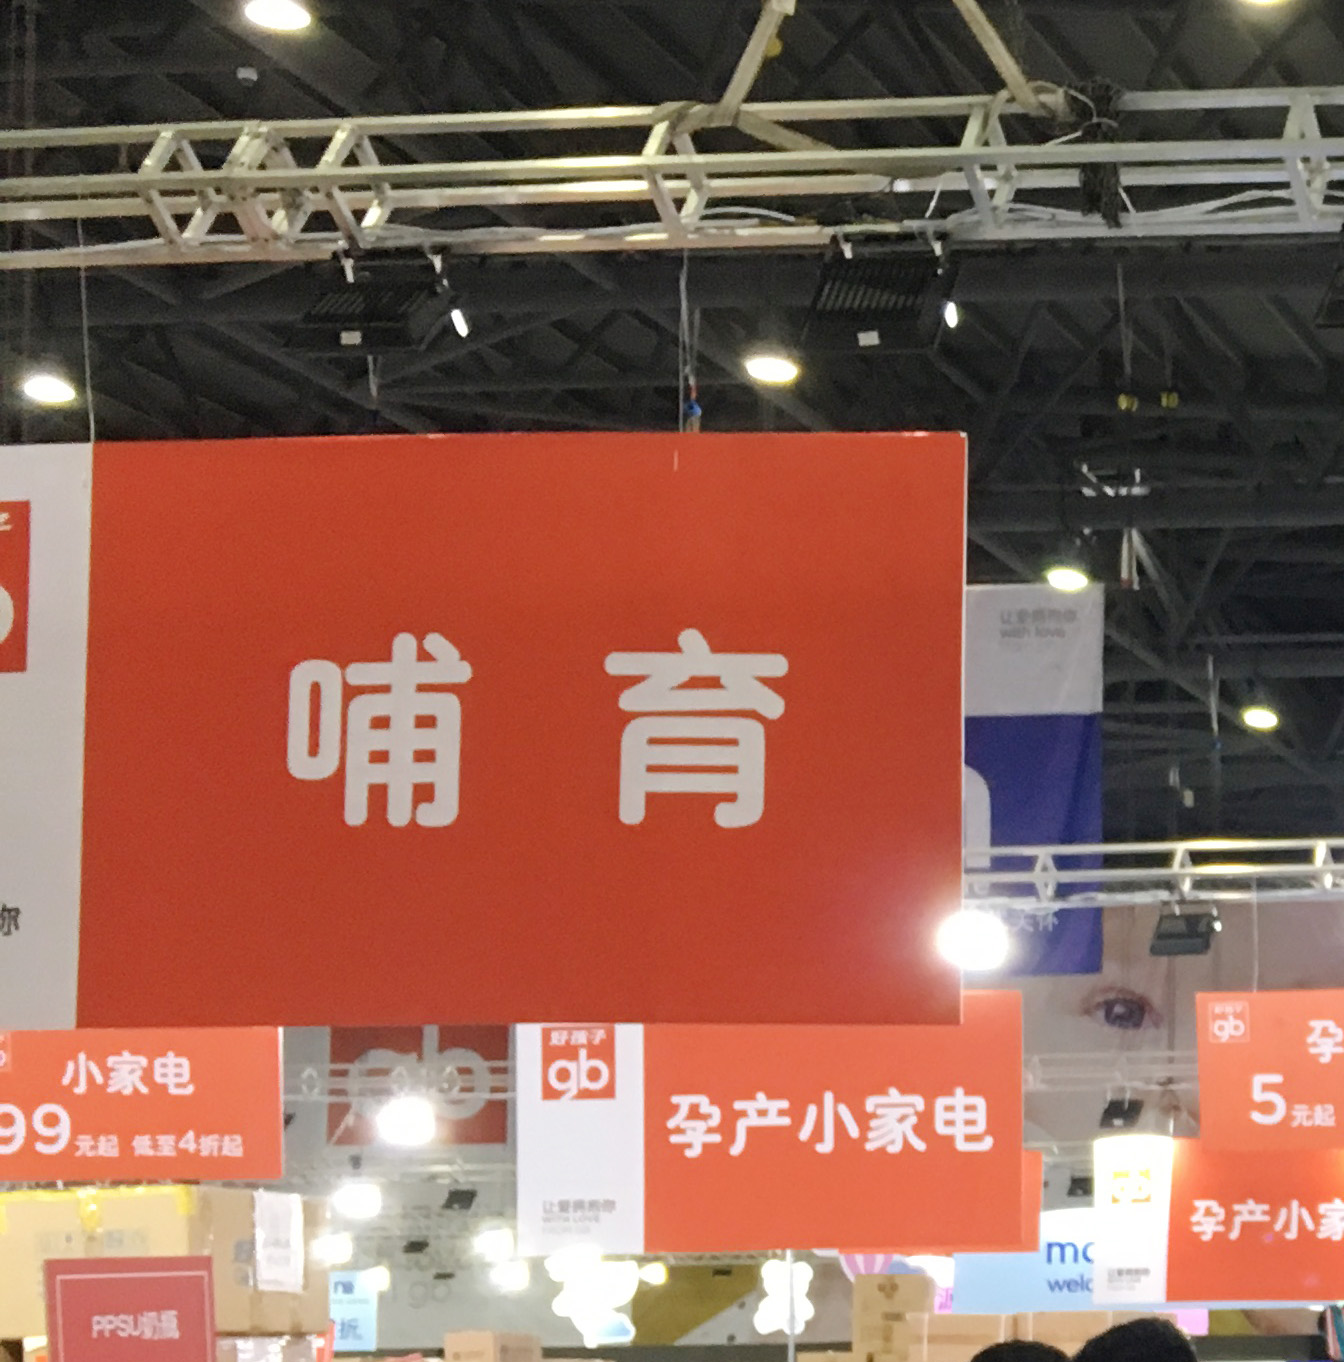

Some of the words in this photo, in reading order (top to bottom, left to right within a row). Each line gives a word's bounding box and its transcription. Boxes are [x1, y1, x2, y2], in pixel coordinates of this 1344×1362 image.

[286, 627, 790, 829] 哺育
[1213, 1014, 1246, 1043] gb
[61, 1050, 195, 1097] 小家电
[547, 1047, 610, 1101] gb
[666, 1086, 995, 1158] 孕产小家电
[1249, 1074, 1336, 1128] 5元起
[131, 1129, 244, 1158] 低至4折起
